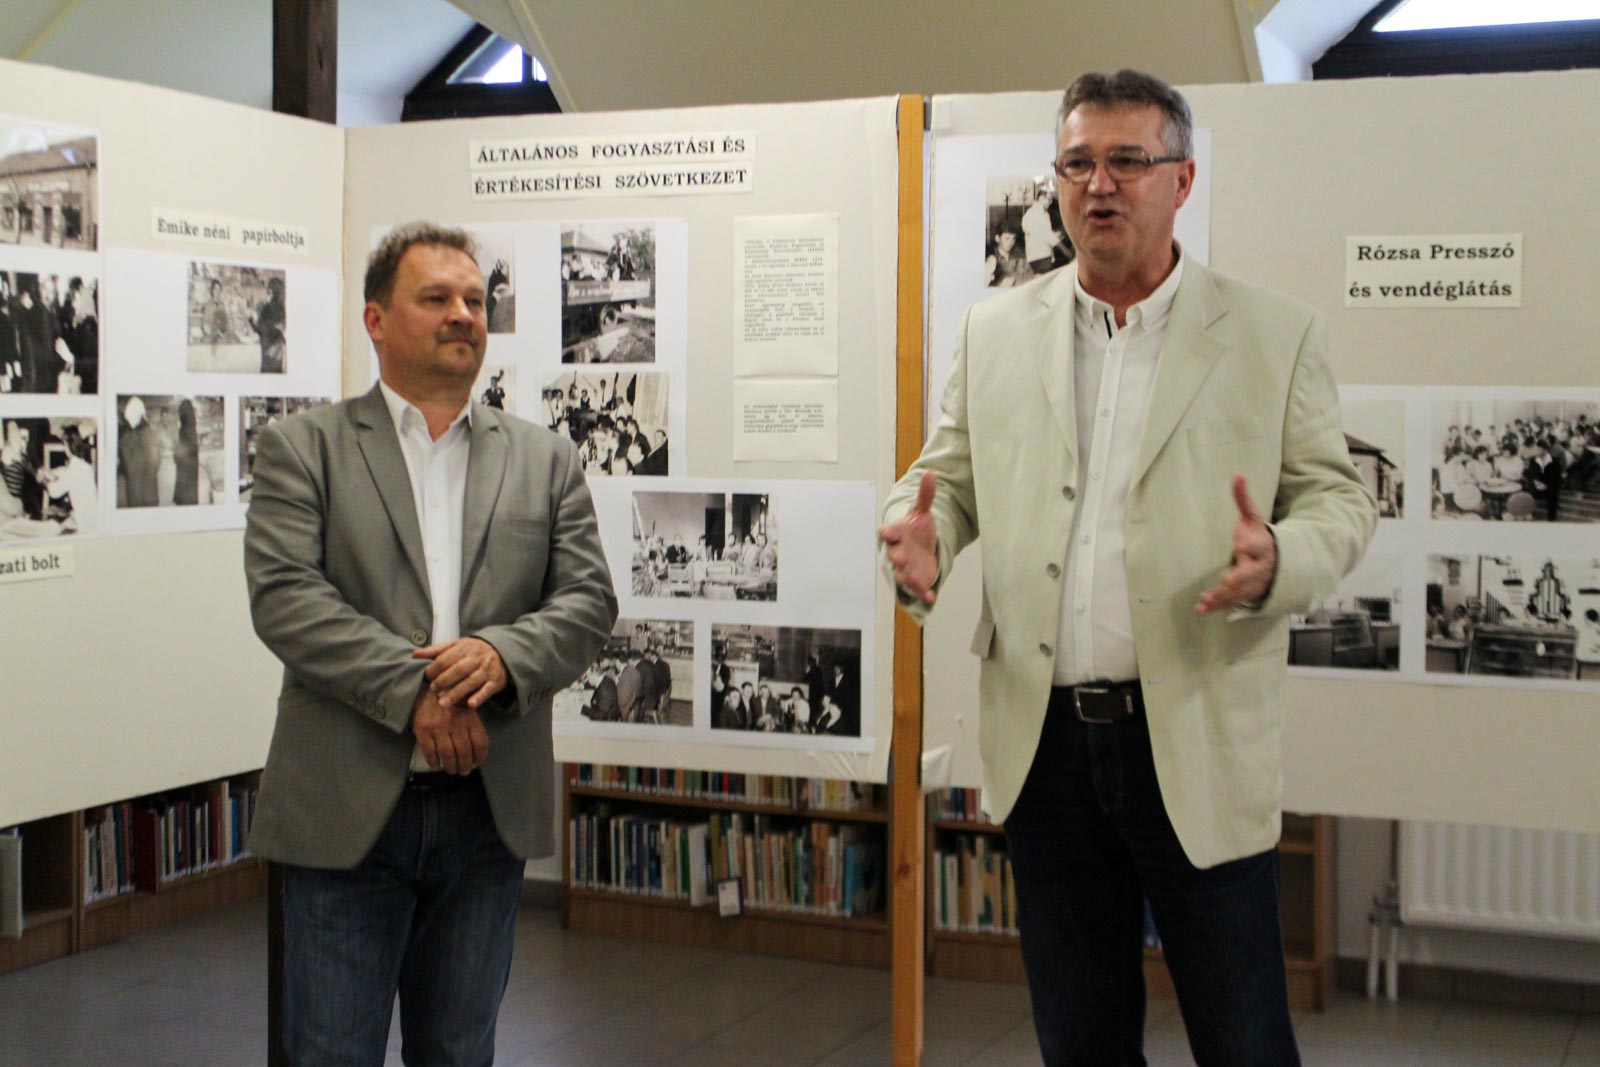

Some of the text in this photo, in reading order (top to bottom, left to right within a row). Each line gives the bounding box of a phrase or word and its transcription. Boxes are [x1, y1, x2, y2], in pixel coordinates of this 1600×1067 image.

[477, 136, 746, 163] ÁLTALÁNOS FOGYASZTÁSI ÉS
[474, 169, 748, 195] ÉRTÉKESÍTÉSI SZÖVETKEZET
[157, 217, 199, 236] Emike
[204, 222, 231, 240] néni
[1357, 242, 1515, 261] Rózsa Presszó
[1349, 279, 1513, 301] és vendéglátás
[31, 553, 61, 571] bolt
